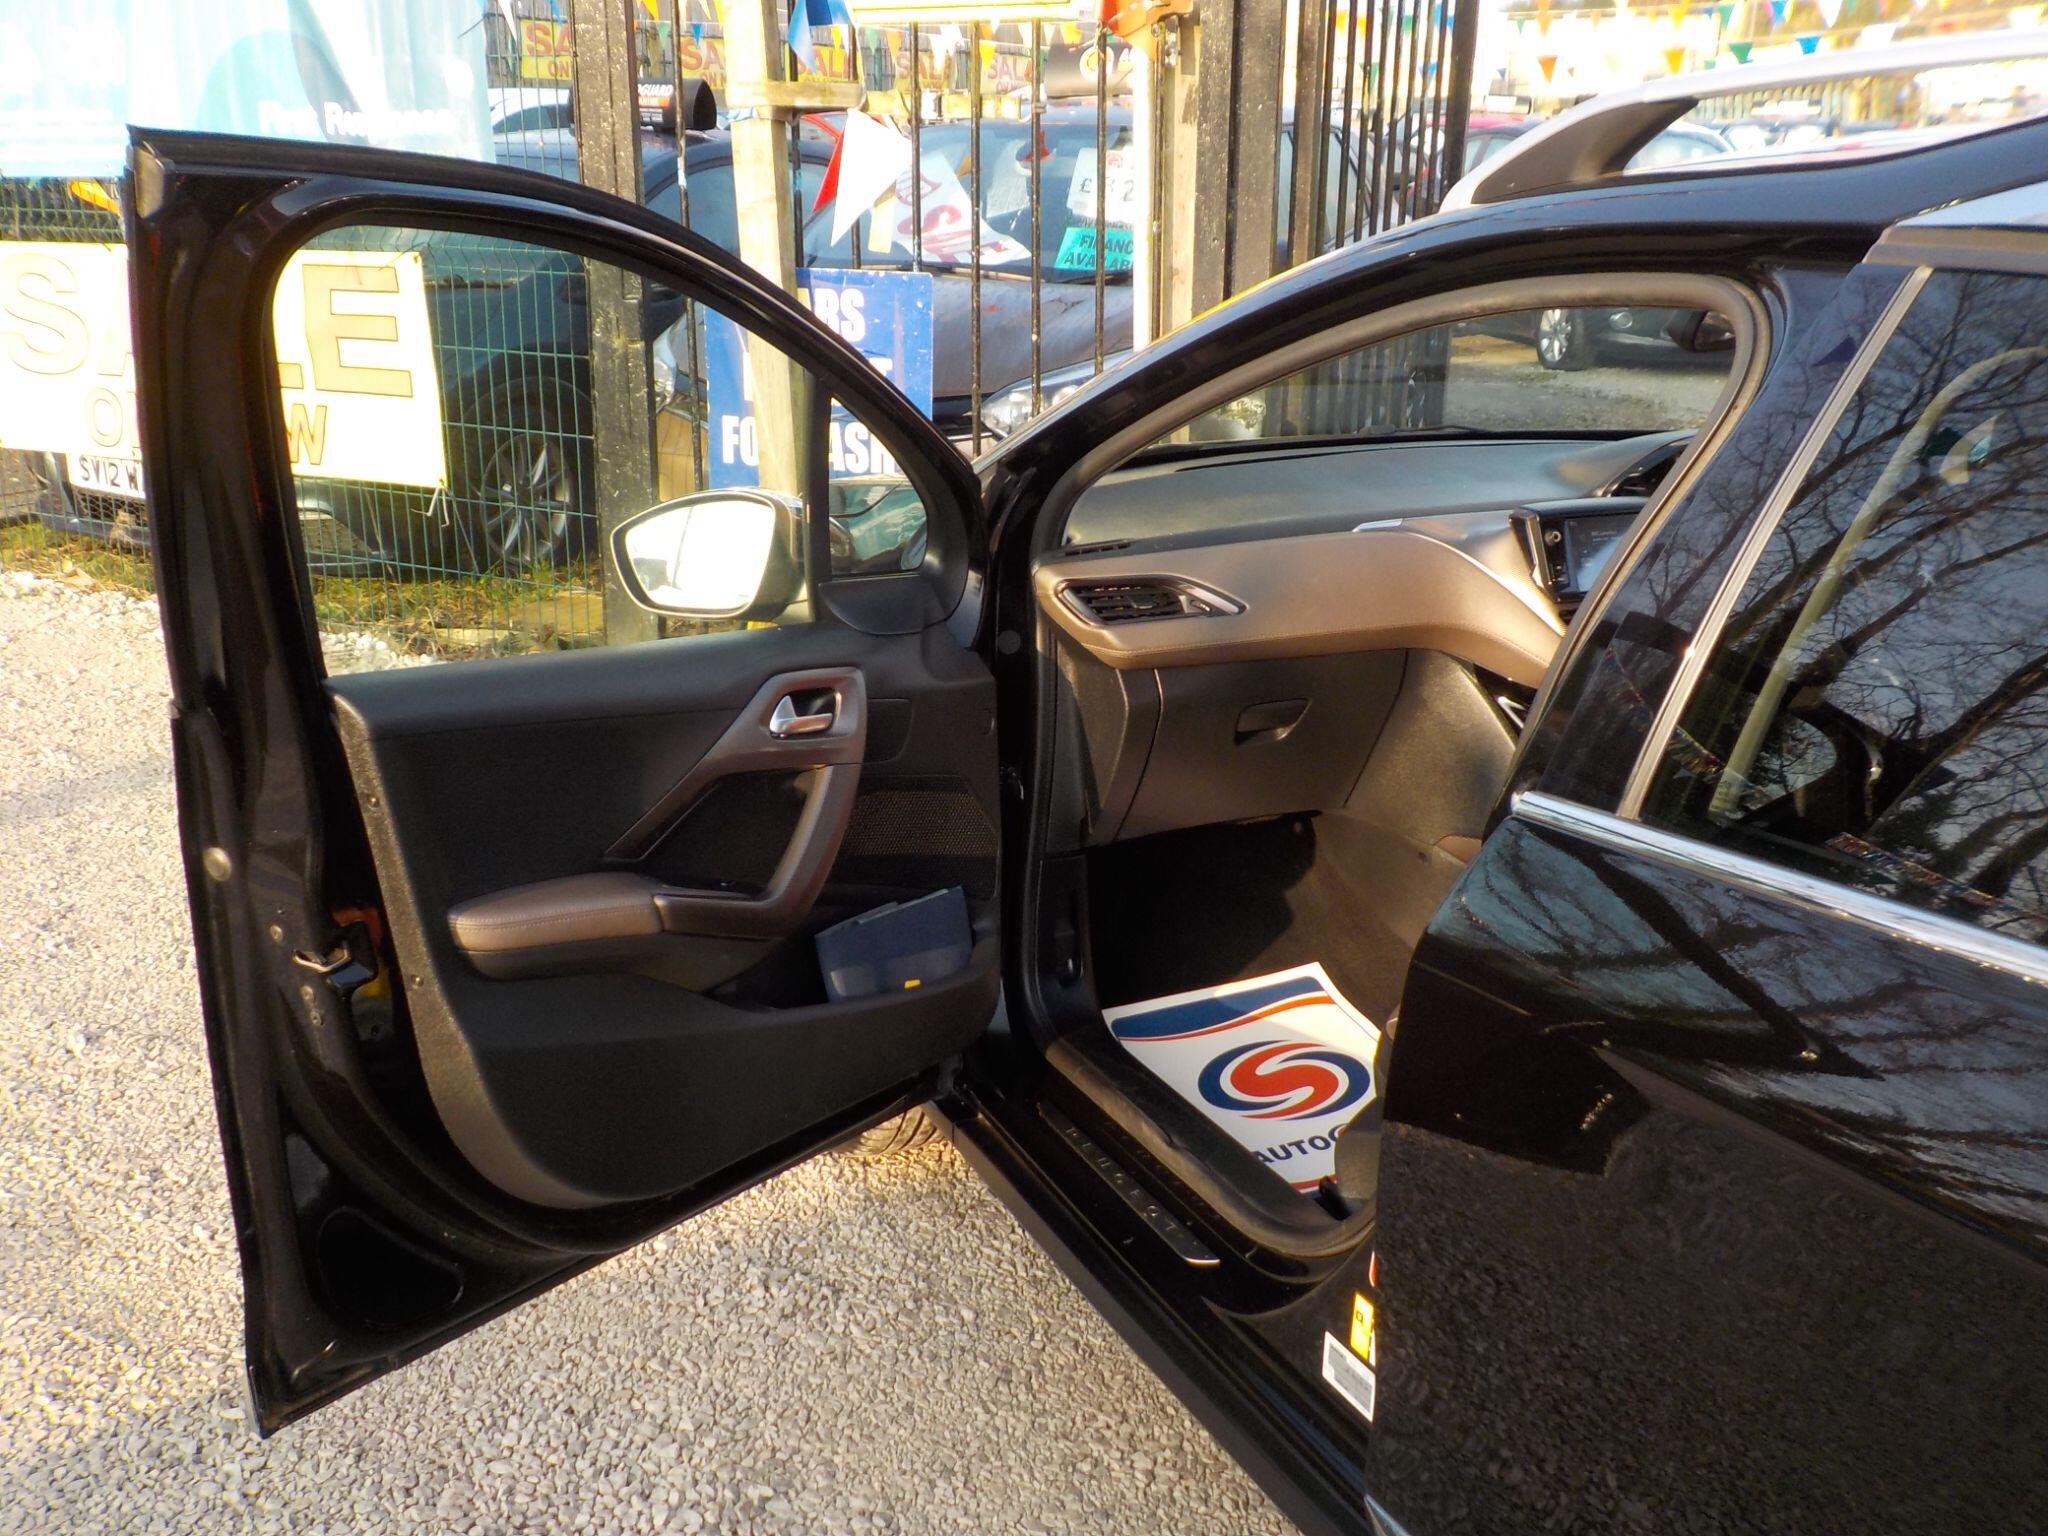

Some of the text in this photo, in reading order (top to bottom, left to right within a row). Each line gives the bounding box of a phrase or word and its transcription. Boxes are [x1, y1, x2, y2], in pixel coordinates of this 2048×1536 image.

[526, 23, 574, 57] SA
[680, 37, 726, 70] SA
[721, 415, 760, 467] FO
[829, 421, 897, 474] ASH
